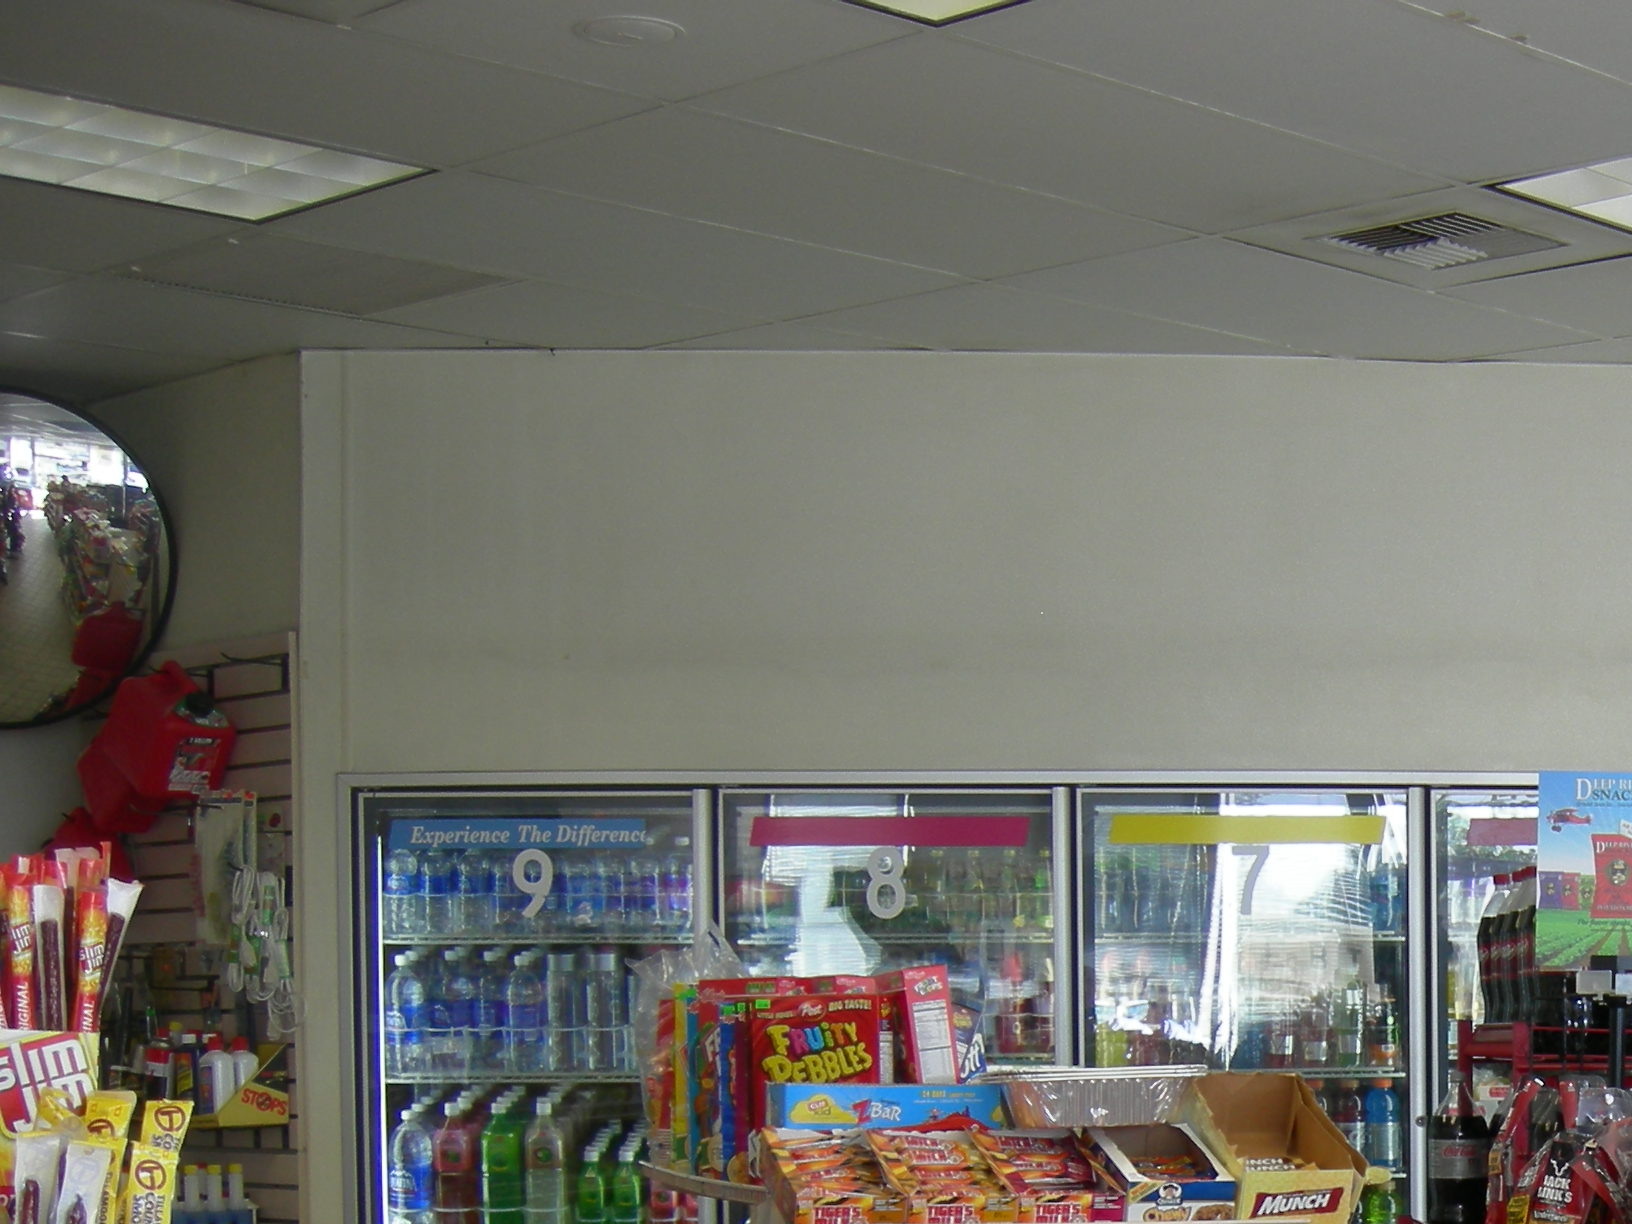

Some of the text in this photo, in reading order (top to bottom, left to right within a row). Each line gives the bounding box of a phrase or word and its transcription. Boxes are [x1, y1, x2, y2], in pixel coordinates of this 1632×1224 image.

[1576, 778, 1615, 801] DEEP
[410, 825, 510, 847] Experience
[517, 825, 551, 844] The
[513, 848, 552, 917] 9
[867, 846, 906, 919] 8
[1231, 846, 1270, 915] 7
[1543, 1175, 1571, 1188] JACK
[814, 1206, 862, 1218] TIGER'S
[928, 1205, 975, 1217] TIGER'S
[1035, 1203, 1081, 1215] TIGER'S
[1258, 1193, 1330, 1217] MUNCH
